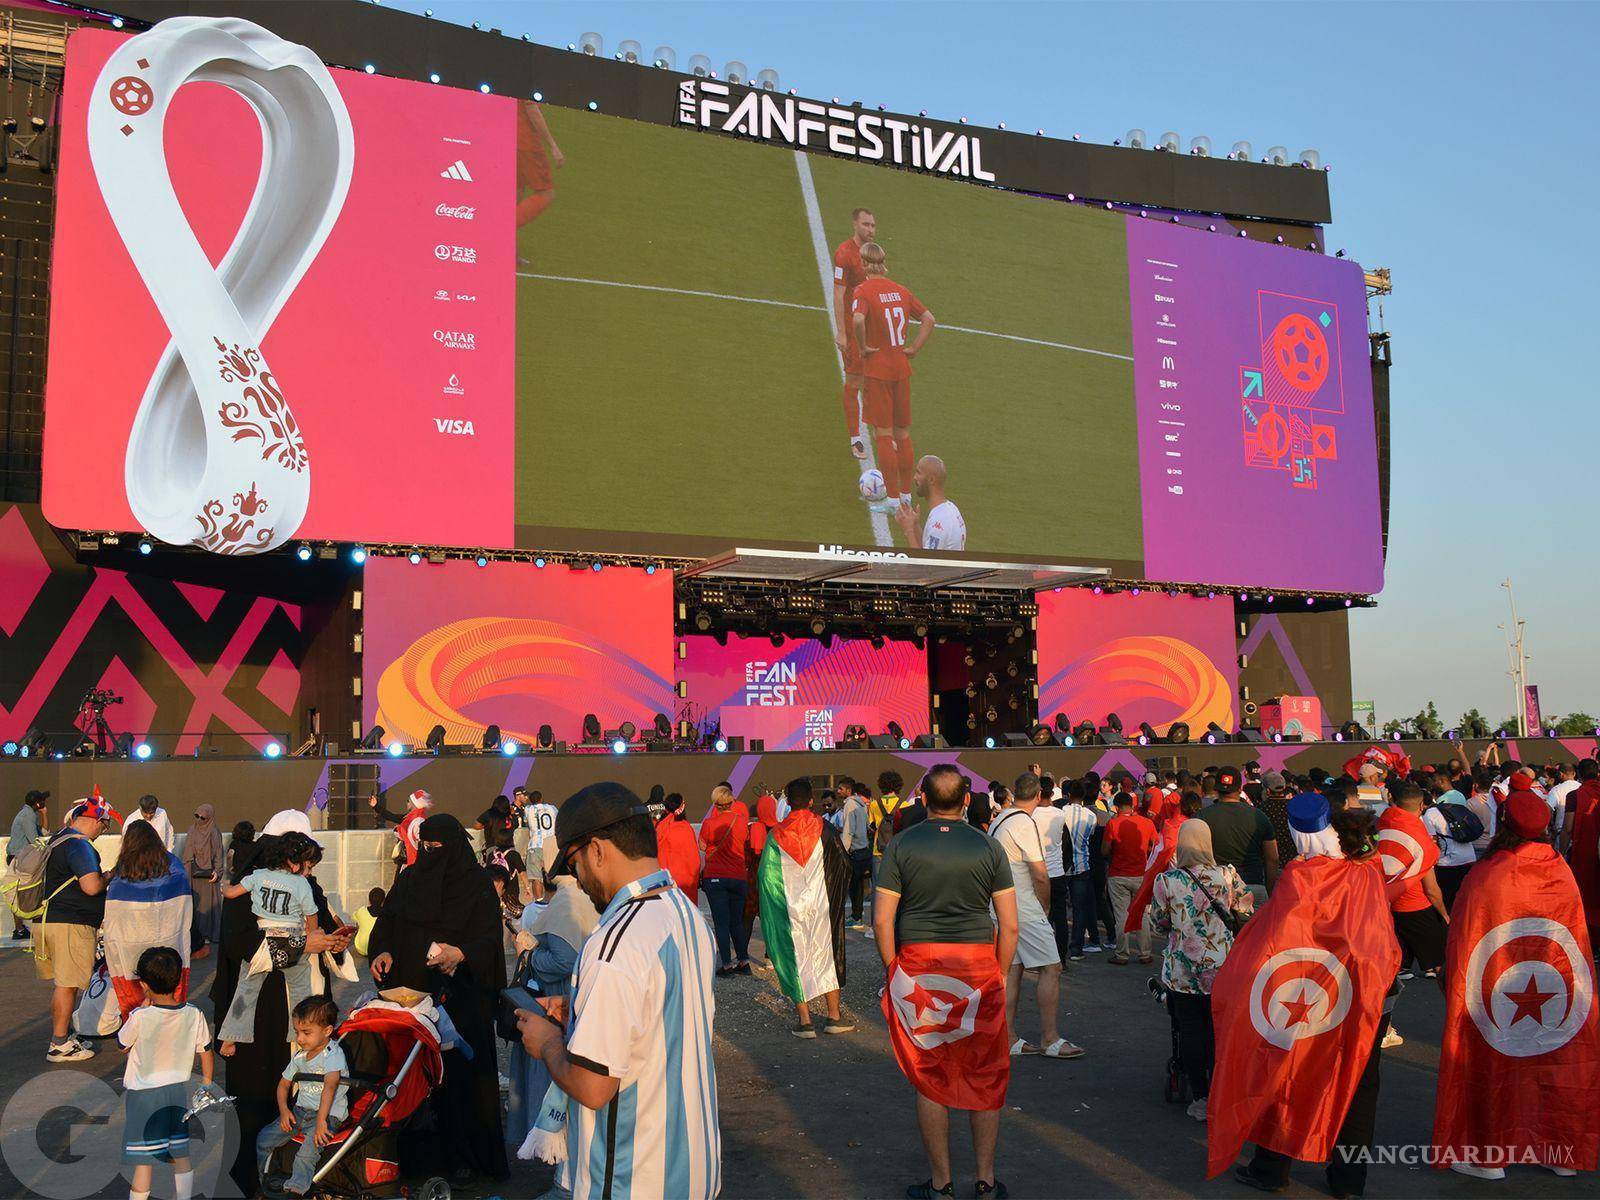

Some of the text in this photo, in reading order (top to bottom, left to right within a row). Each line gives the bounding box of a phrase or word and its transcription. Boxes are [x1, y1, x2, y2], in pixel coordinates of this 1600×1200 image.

[680, 80, 696, 124] FIFA
[885, 307, 905, 346] 12
[433, 330, 475, 344] QATAR
[443, 341, 476, 351] AIRWAYS
[433, 418, 475, 436] VISA
[746, 661, 754, 683] FIFA
[754, 661, 796, 683] FAN
[746, 685, 798, 706] FEST
[809, 709, 833, 722] FAN
[805, 722, 834, 736] FEST
[535, 811, 553, 830] 10
